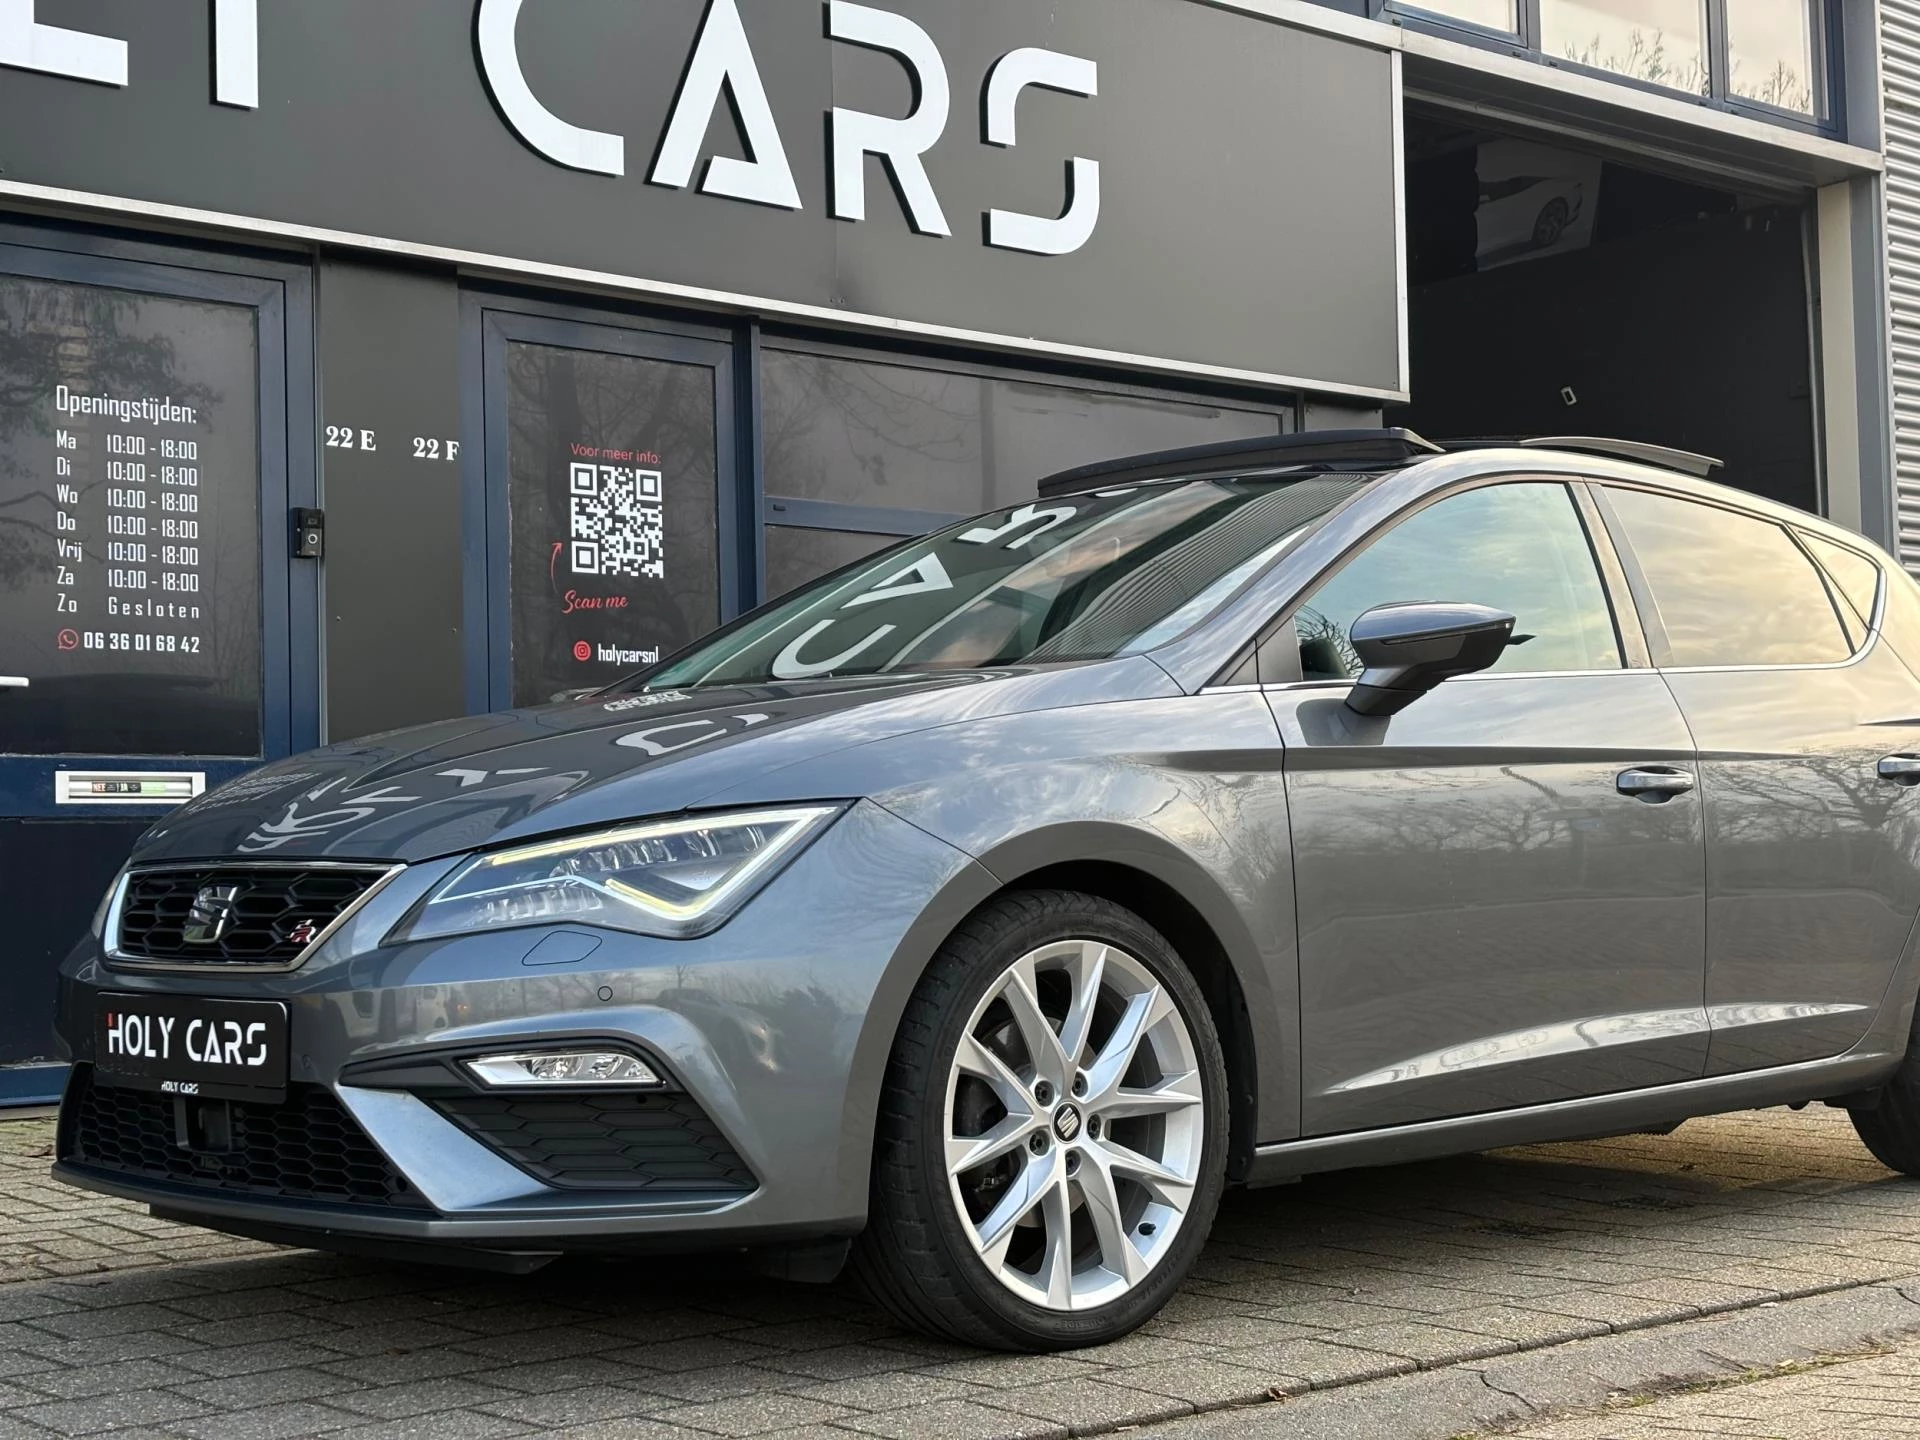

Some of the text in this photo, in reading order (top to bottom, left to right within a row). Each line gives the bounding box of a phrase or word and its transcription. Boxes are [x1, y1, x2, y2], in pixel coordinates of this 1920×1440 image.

[477, 0, 1099, 254] CARS
[56, 385, 197, 425] Openingstijden:
[57, 430, 76, 449] Ma
[107, 435, 145, 455] 10:00
[161, 440, 196, 460] 18:00
[326, 426, 376, 450] 22 E
[414, 438, 460, 461] 22 F
[570, 443, 662, 464] Voor meer info:
[57, 457, 70, 475] Di
[108, 462, 145, 481] 10:00
[162, 466, 197, 486] 18:00
[57, 484, 77, 503] Wo
[108, 489, 145, 508] 10:00
[162, 493, 197, 512] 18:00
[58, 512, 75, 530] Do
[108, 516, 145, 535] 10:00
[162, 520, 197, 538] 18:00
[58, 539, 81, 562] Vrij
[108, 542, 146, 562] 10:00
[162, 546, 198, 565] 18:00
[57, 566, 73, 584] Za
[109, 569, 146, 588] 10:00
[163, 574, 198, 591] 18:00
[58, 593, 199, 618] Zo Gesloten
[562, 589, 628, 614] Scan me
[84, 632, 199, 652] 06 36 01 68 42
[598, 644, 658, 665] holycarsnl
[107, 1013, 267, 1066] HOLY CARS
[161, 1080, 199, 1095] HOLY CARS
